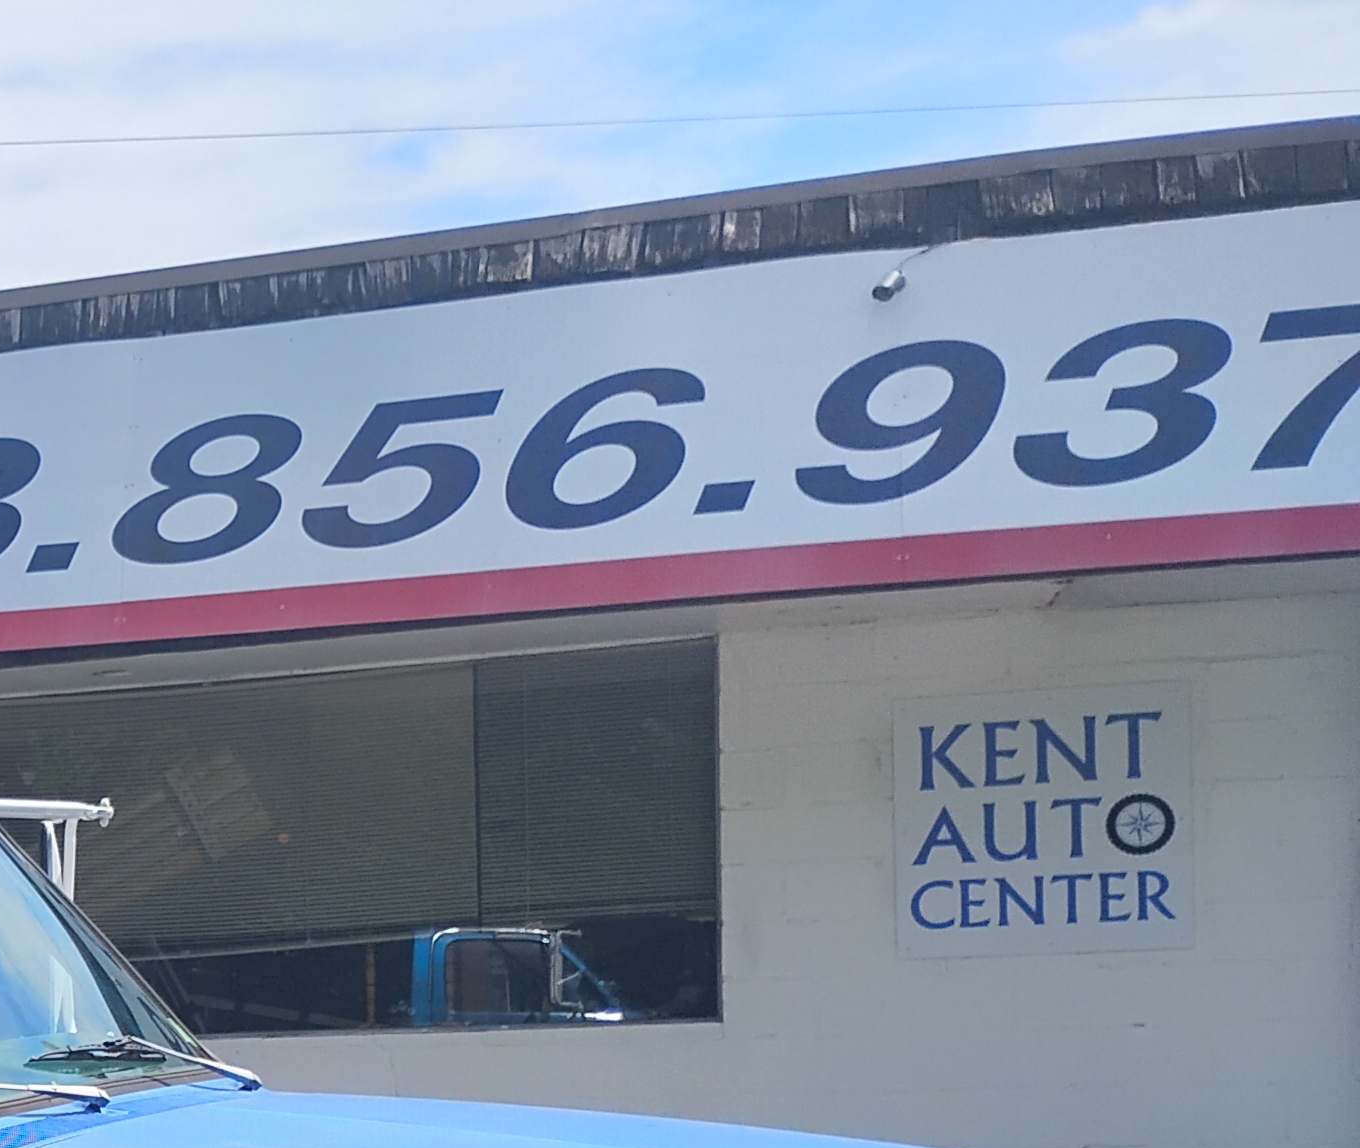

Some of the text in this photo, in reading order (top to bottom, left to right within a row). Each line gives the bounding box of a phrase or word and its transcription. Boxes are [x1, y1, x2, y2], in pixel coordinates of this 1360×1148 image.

[917, 709, 1162, 791] KENT
[911, 793, 1177, 866] AUTO
[909, 869, 1177, 930] CENTER
